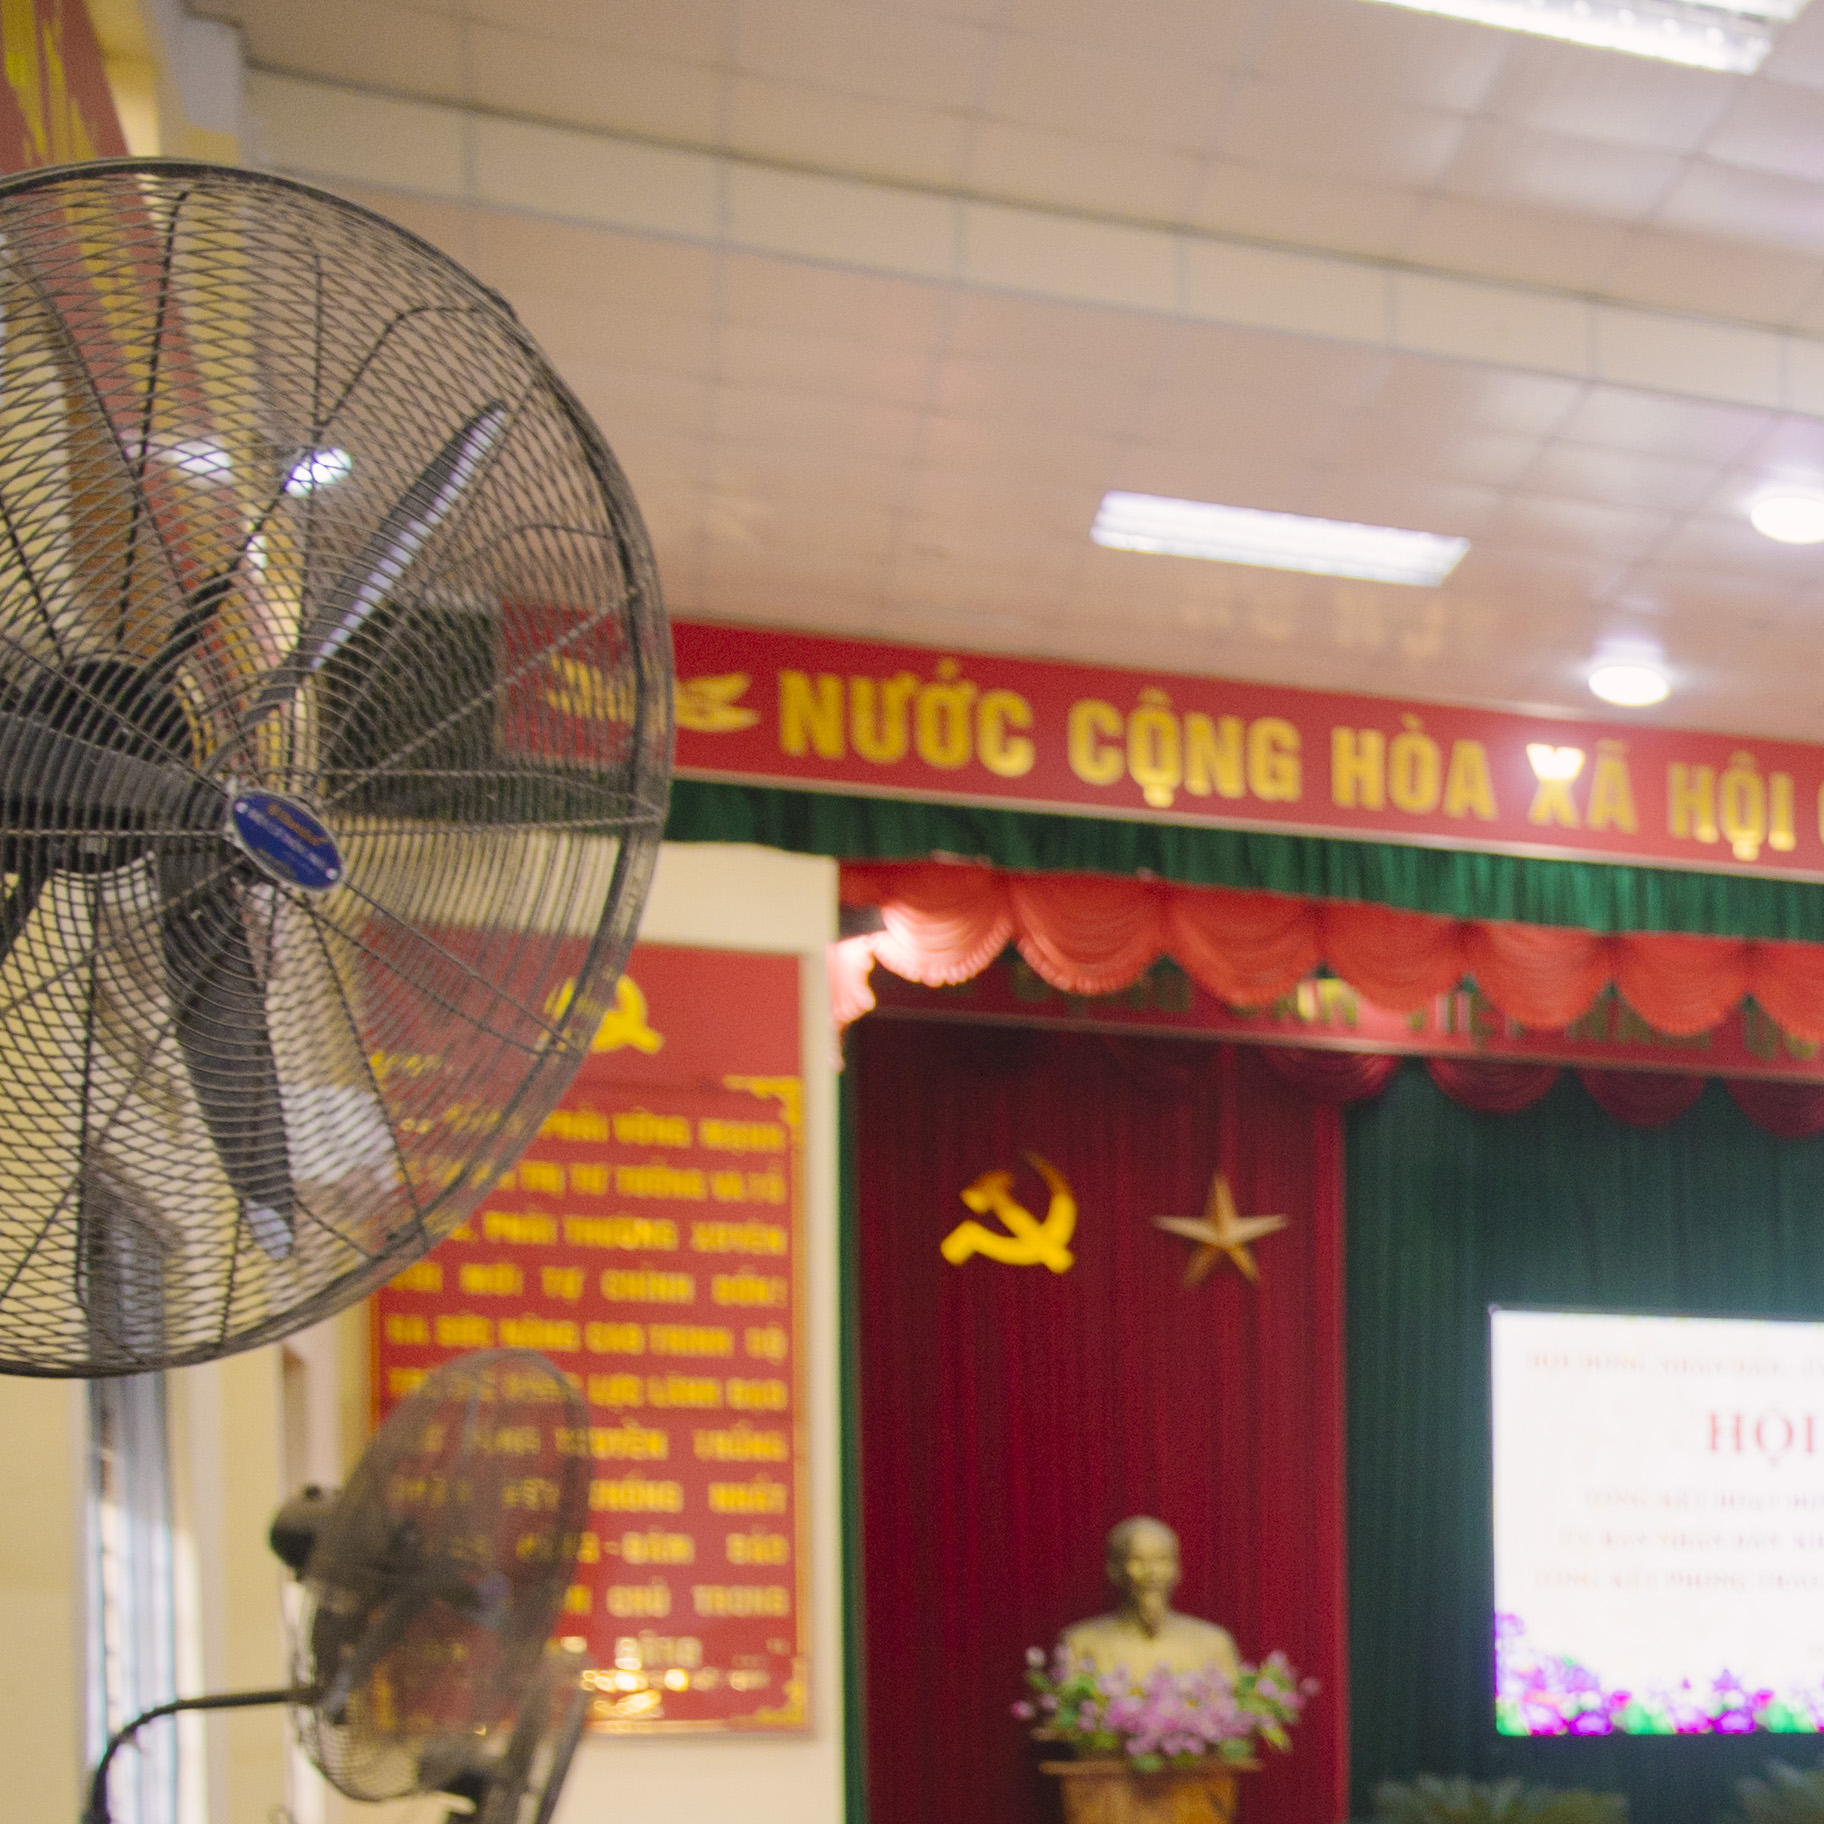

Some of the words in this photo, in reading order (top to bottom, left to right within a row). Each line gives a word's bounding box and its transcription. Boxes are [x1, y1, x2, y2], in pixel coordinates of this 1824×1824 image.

[779, 660, 1035, 777] NƯỚC
[1069, 688, 1303, 806] CỘNG
[1333, 712, 1498, 821] HÒA
[1526, 738, 1638, 832] XÃ
[1668, 754, 1794, 860] HỘI
[1706, 1408, 1817, 1467] HỘI
